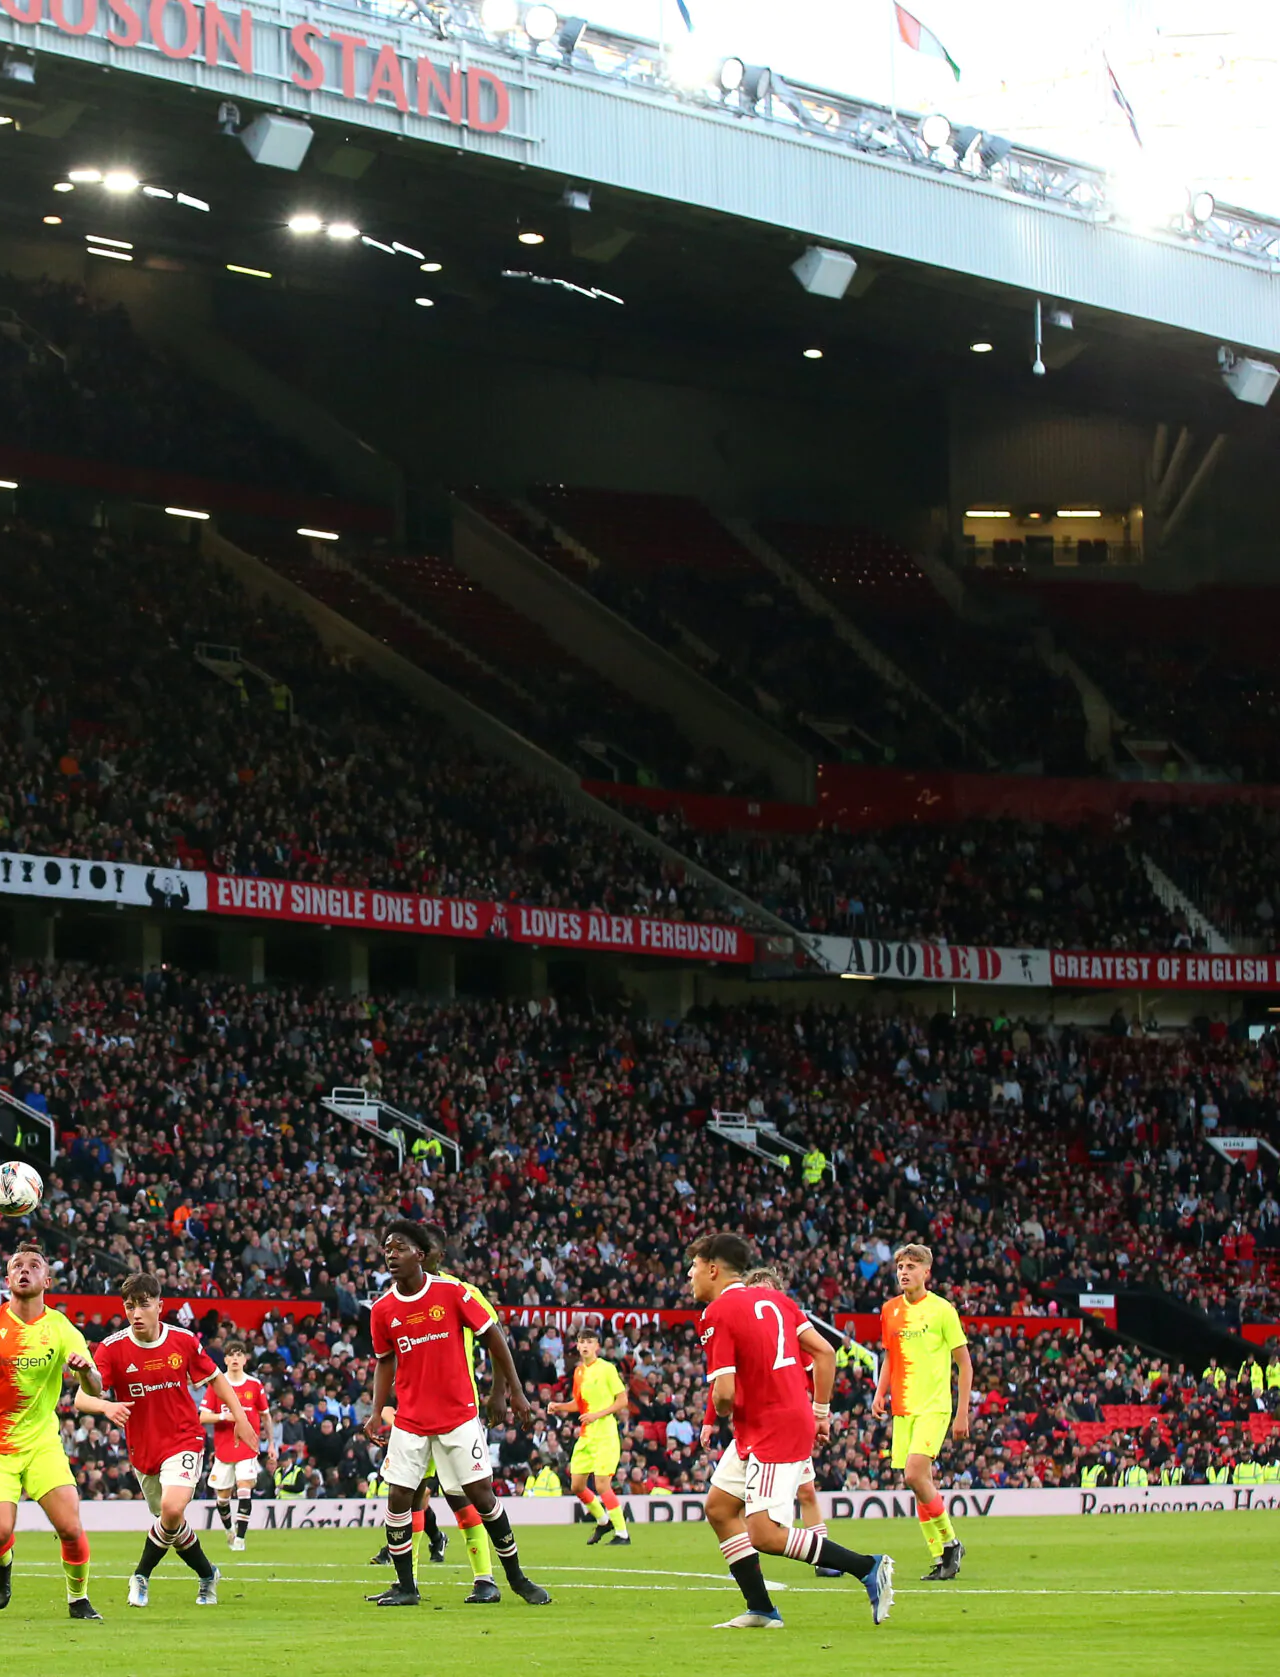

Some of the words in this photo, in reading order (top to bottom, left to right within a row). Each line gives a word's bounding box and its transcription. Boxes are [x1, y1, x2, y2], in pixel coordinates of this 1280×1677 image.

[291, 24, 510, 133] STAND
[218, 877, 284, 911] EVERY
[291, 885, 365, 920] SINGLE
[372, 893, 414, 924] ONE
[419, 898, 444, 927] OF
[450, 902, 478, 930] US
[521, 908, 582, 940] LOVES
[588, 915, 633, 945] ALEX
[639, 919, 738, 955] FERGUSON
[846, 937, 1002, 980] ADORED
[1054, 954, 1150, 981] GREATEST
[1157, 958, 1180, 981] OF
[1186, 958, 1268, 983] ENGLISH
[754, 1300, 797, 1370] 2
[182, 1453, 194, 1470] 8
[471, 1438, 483, 1460] 6
[746, 1462, 760, 1490] 2
